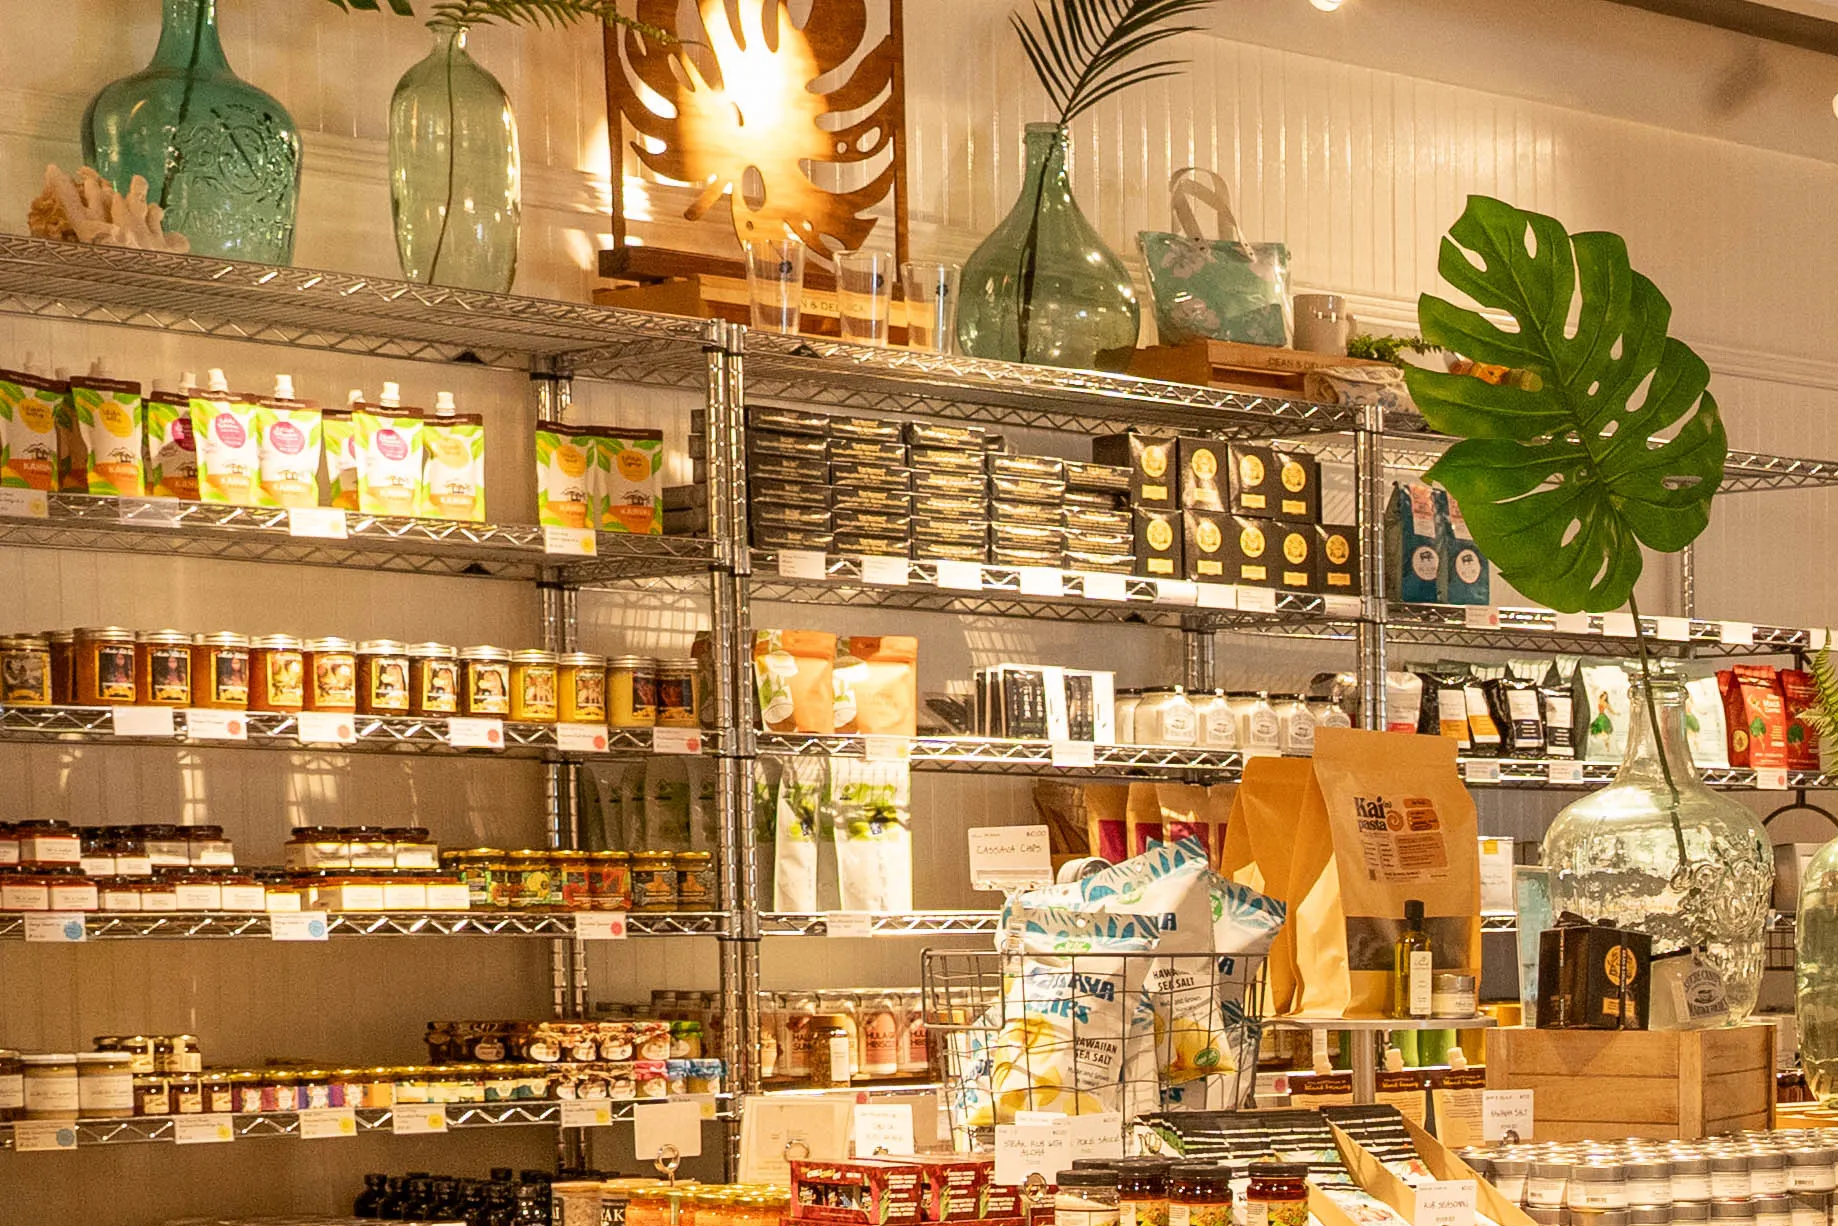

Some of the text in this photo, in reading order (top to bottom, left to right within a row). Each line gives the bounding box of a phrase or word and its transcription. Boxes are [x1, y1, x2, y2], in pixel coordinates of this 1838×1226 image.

[1353, 796, 1386, 818] Kai
[1358, 819, 1388, 832] pasta
[1174, 976, 1195, 990] SALT
[1076, 1036, 1118, 1054] HAWAIIAN
[1093, 1052, 1113, 1066] SALT
